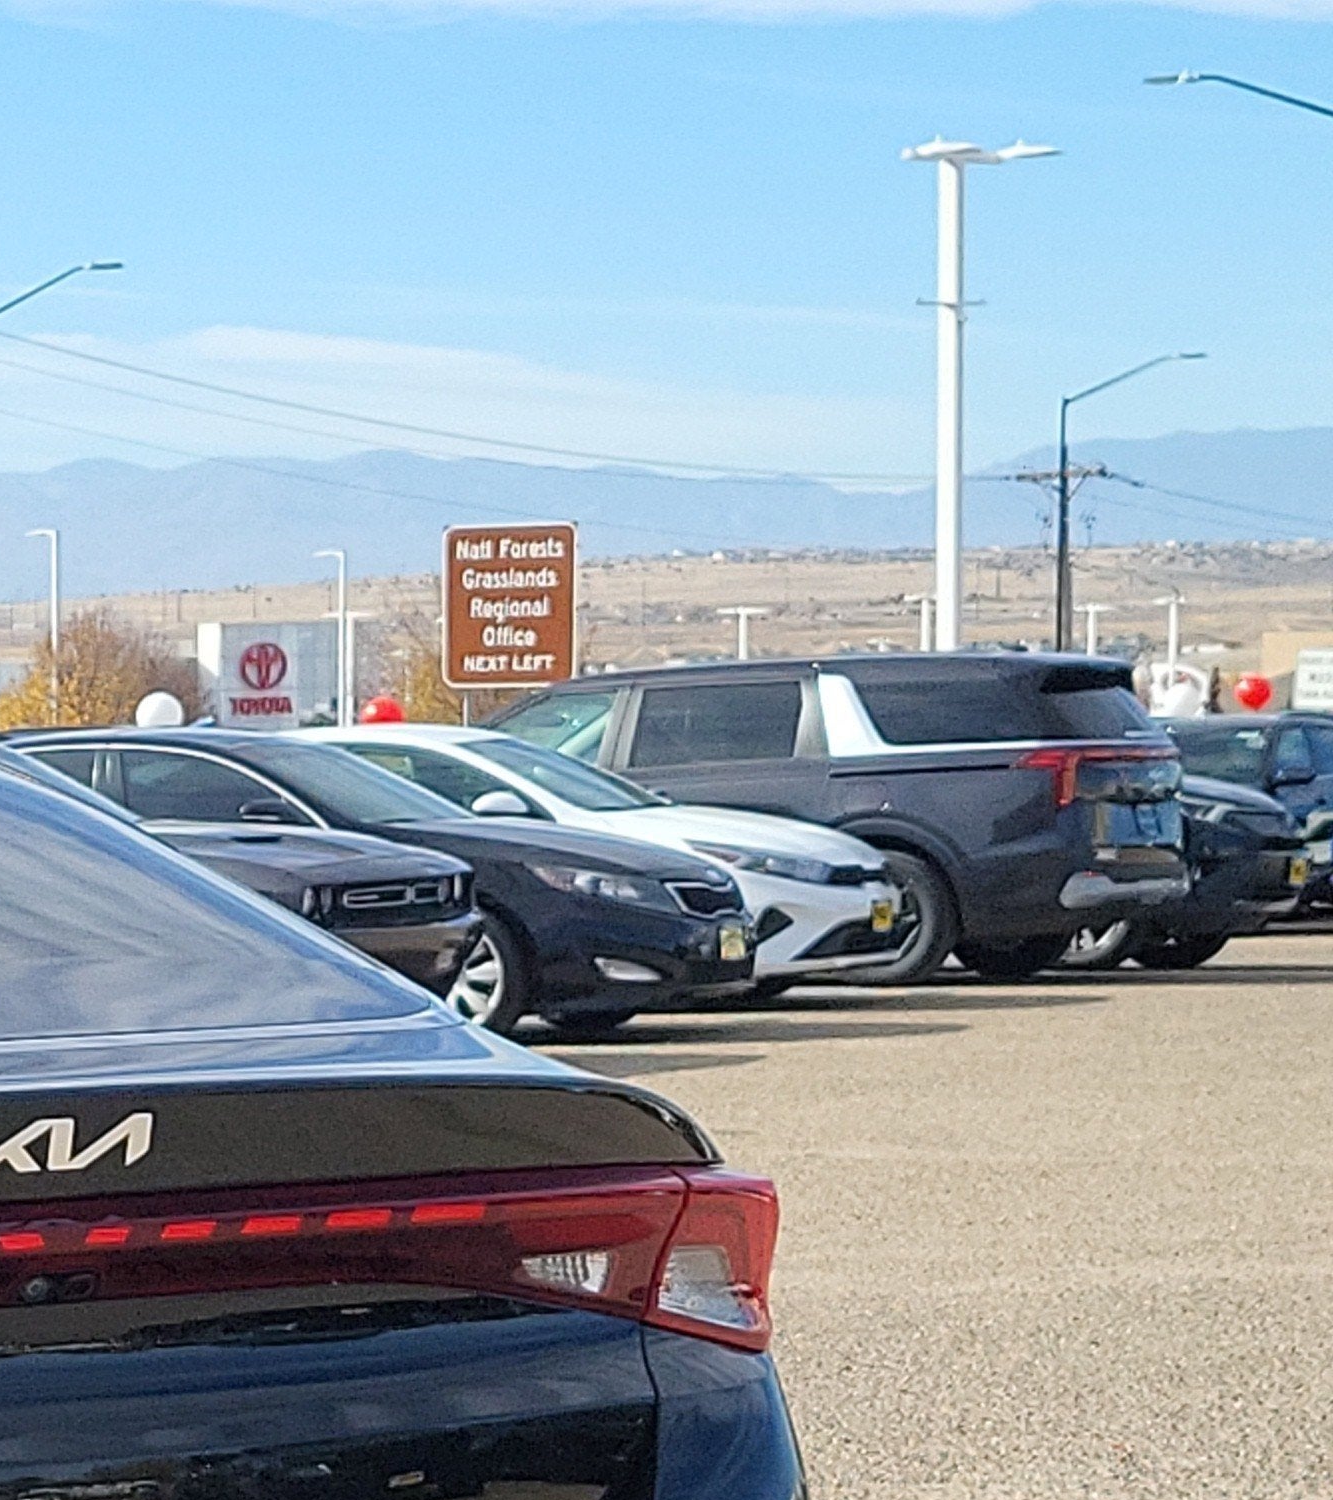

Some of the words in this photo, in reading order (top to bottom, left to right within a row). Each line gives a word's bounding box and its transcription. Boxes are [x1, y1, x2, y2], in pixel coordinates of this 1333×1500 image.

[499, 536, 565, 559] Forests
[462, 566, 560, 590] Grasslands
[470, 594, 551, 624] Regional
[483, 625, 538, 647] Office
[463, 655, 508, 672] NEXT
[511, 654, 556, 672] LEFT
[229, 696, 293, 716] TOYOTA
